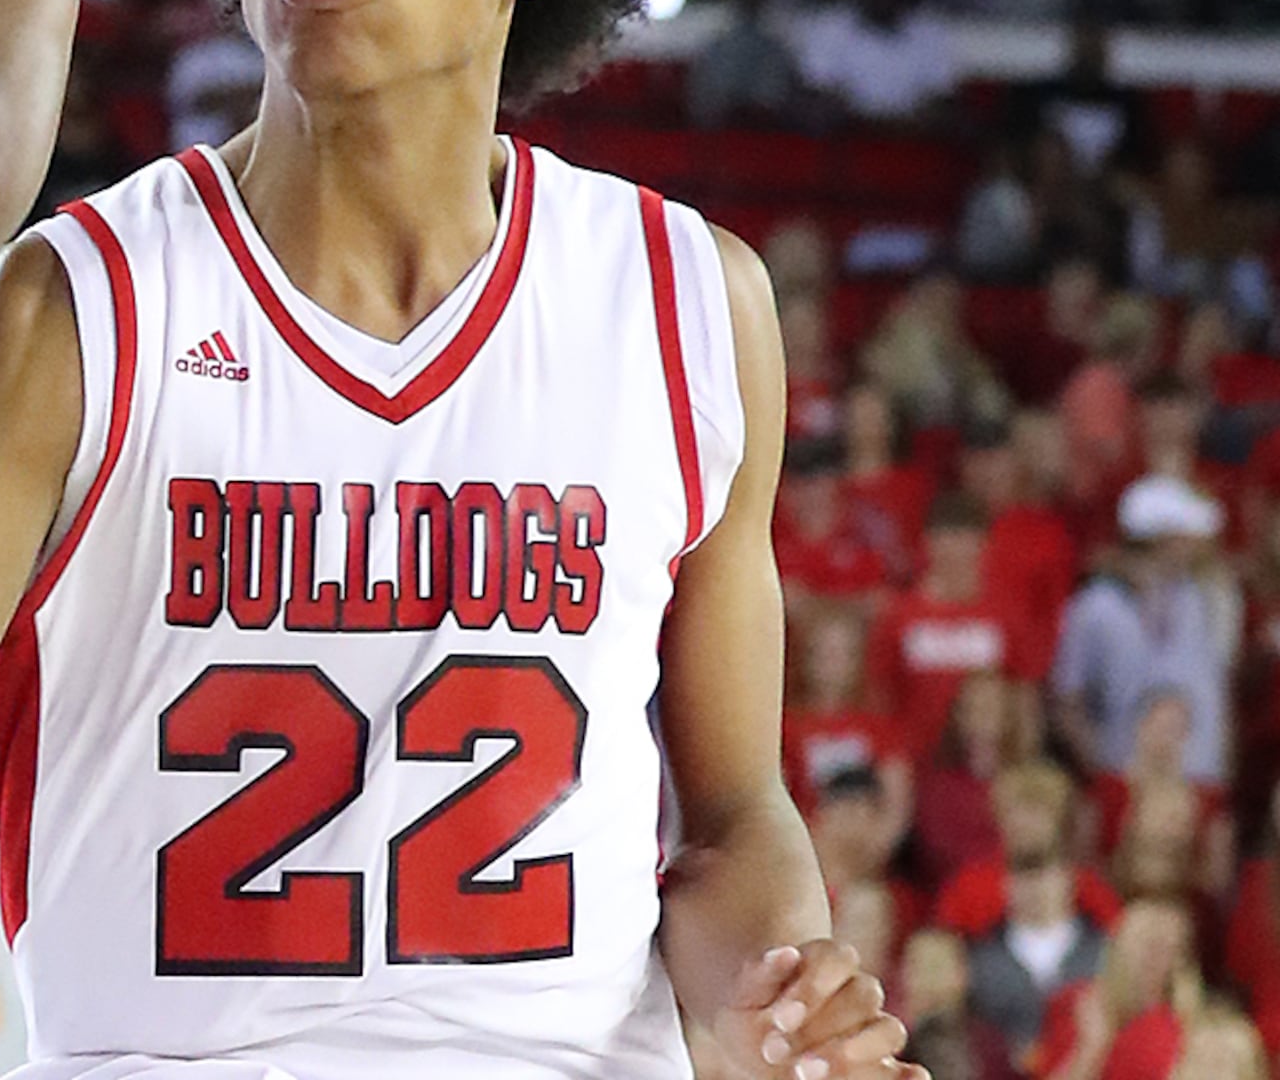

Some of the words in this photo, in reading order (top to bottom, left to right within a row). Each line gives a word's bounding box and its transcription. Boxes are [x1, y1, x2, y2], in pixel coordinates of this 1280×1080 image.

[175, 358, 250, 383] adidas
[165, 477, 608, 634] BULLDOGS
[154, 654, 589, 977] 22
